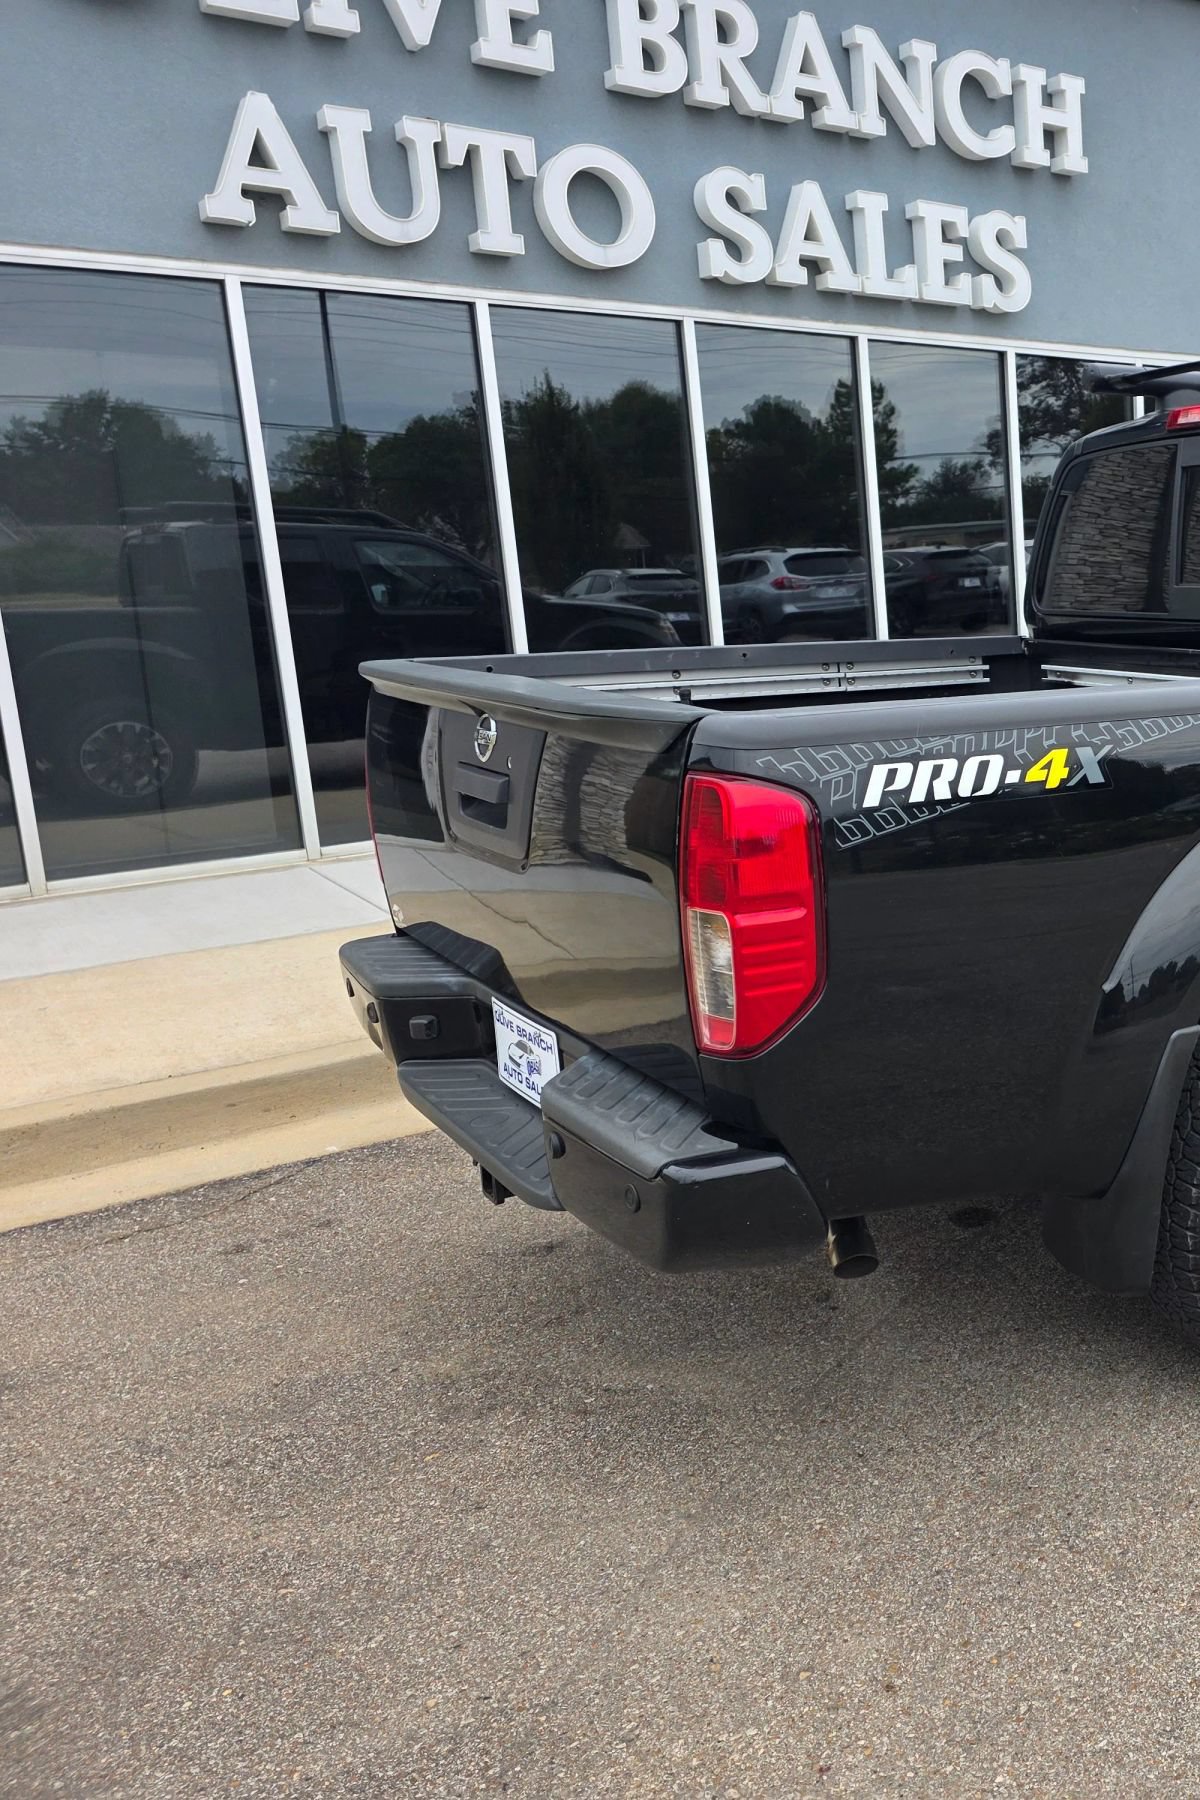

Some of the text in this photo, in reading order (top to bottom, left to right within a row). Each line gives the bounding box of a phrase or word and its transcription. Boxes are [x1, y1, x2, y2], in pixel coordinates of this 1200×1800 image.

[604, 0, 1089, 175] BRANCH
[199, 91, 1032, 313] AUTO SALES
[862, 743, 1113, 808] PRO-4X
[516, 1025, 553, 1055] BRANCH
[503, 1062, 523, 1084] AUTO
